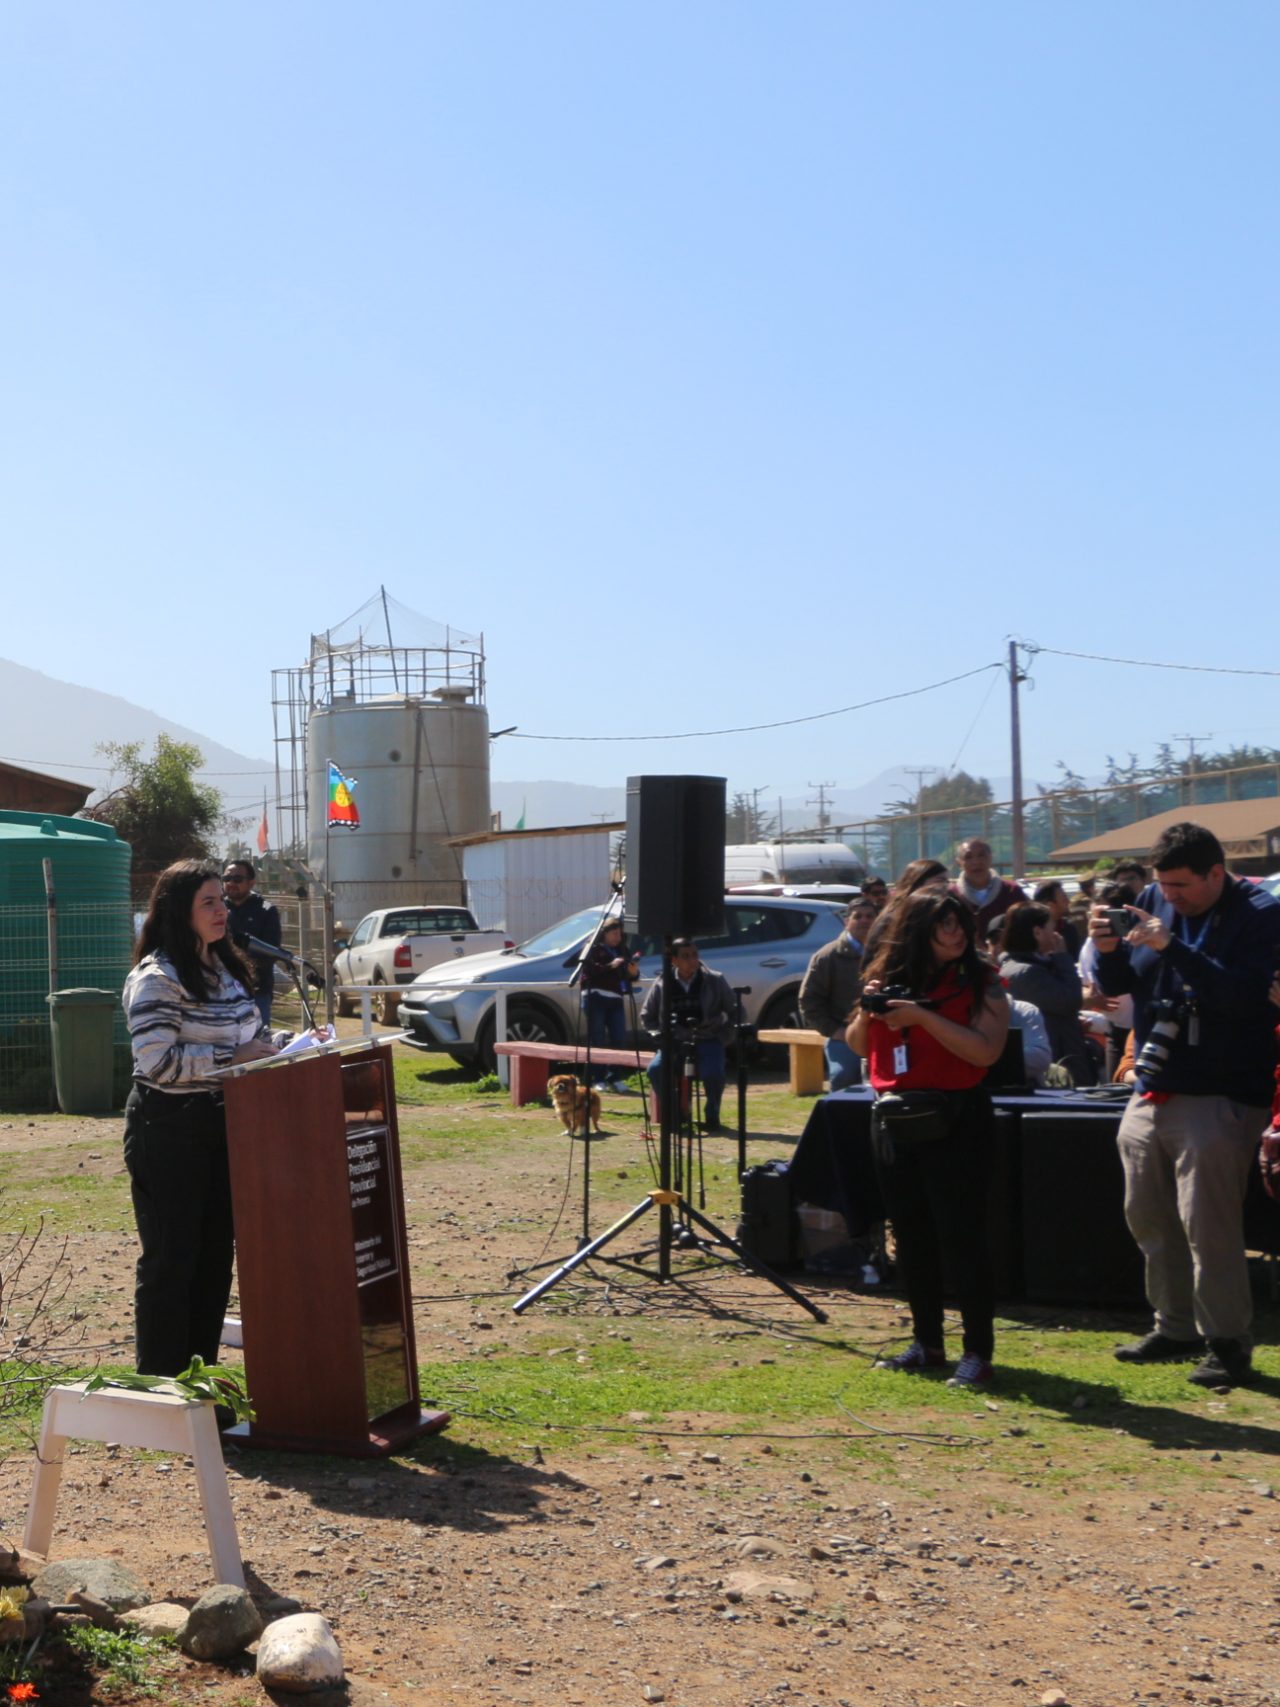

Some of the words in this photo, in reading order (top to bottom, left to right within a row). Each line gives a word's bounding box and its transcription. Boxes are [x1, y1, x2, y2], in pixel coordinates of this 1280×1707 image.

[347, 1140, 378, 1159] Delegación
[349, 1157, 381, 1177] Presidencial
[350, 1174, 377, 1194] Provincial
